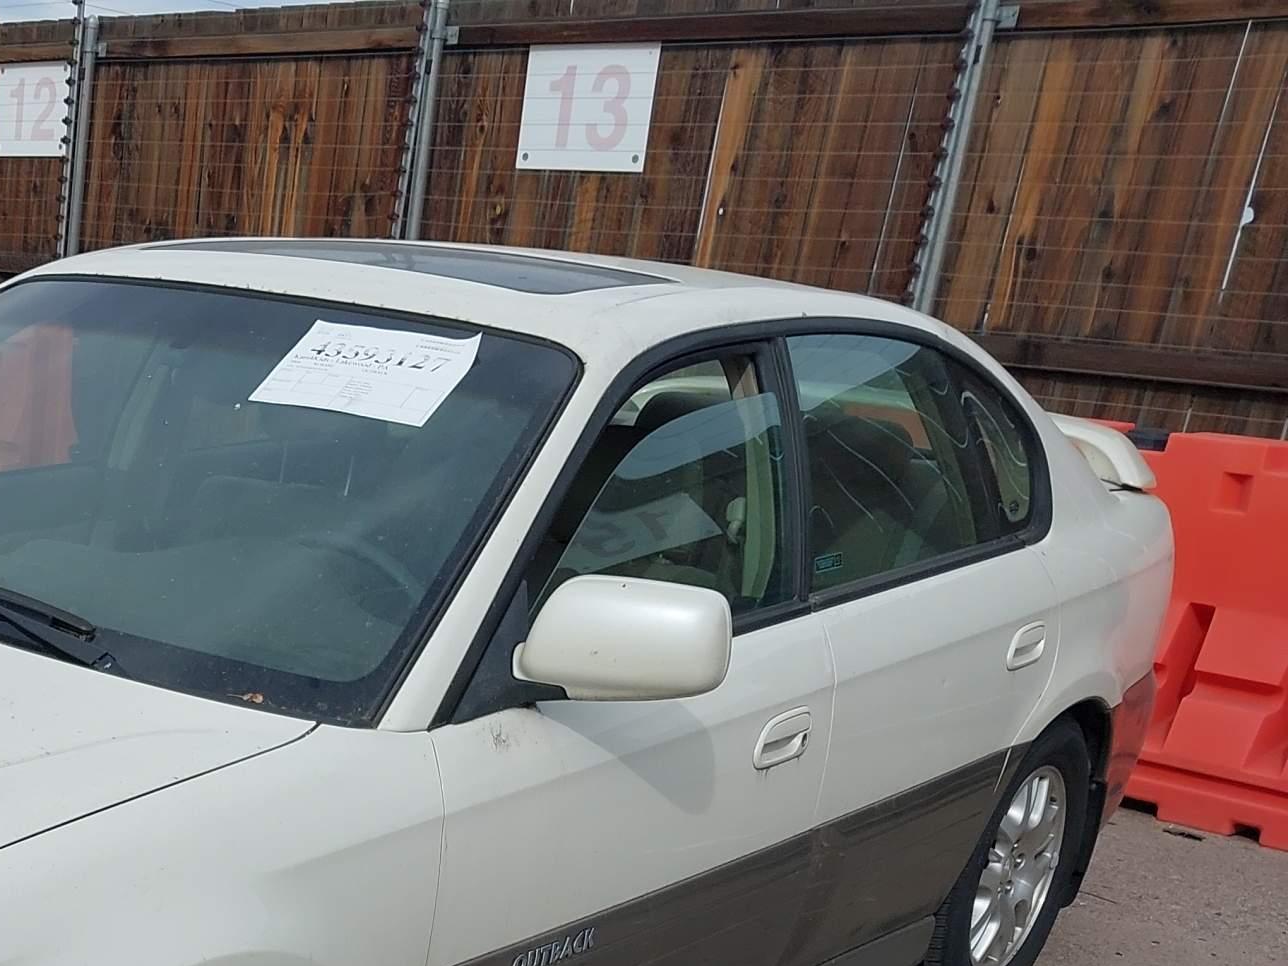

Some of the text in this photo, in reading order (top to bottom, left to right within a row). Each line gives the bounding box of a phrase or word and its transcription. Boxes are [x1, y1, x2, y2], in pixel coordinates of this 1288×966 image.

[10, 77, 57, 141] 12
[549, 64, 632, 152] 13
[311, 341, 452, 373] 43593127
